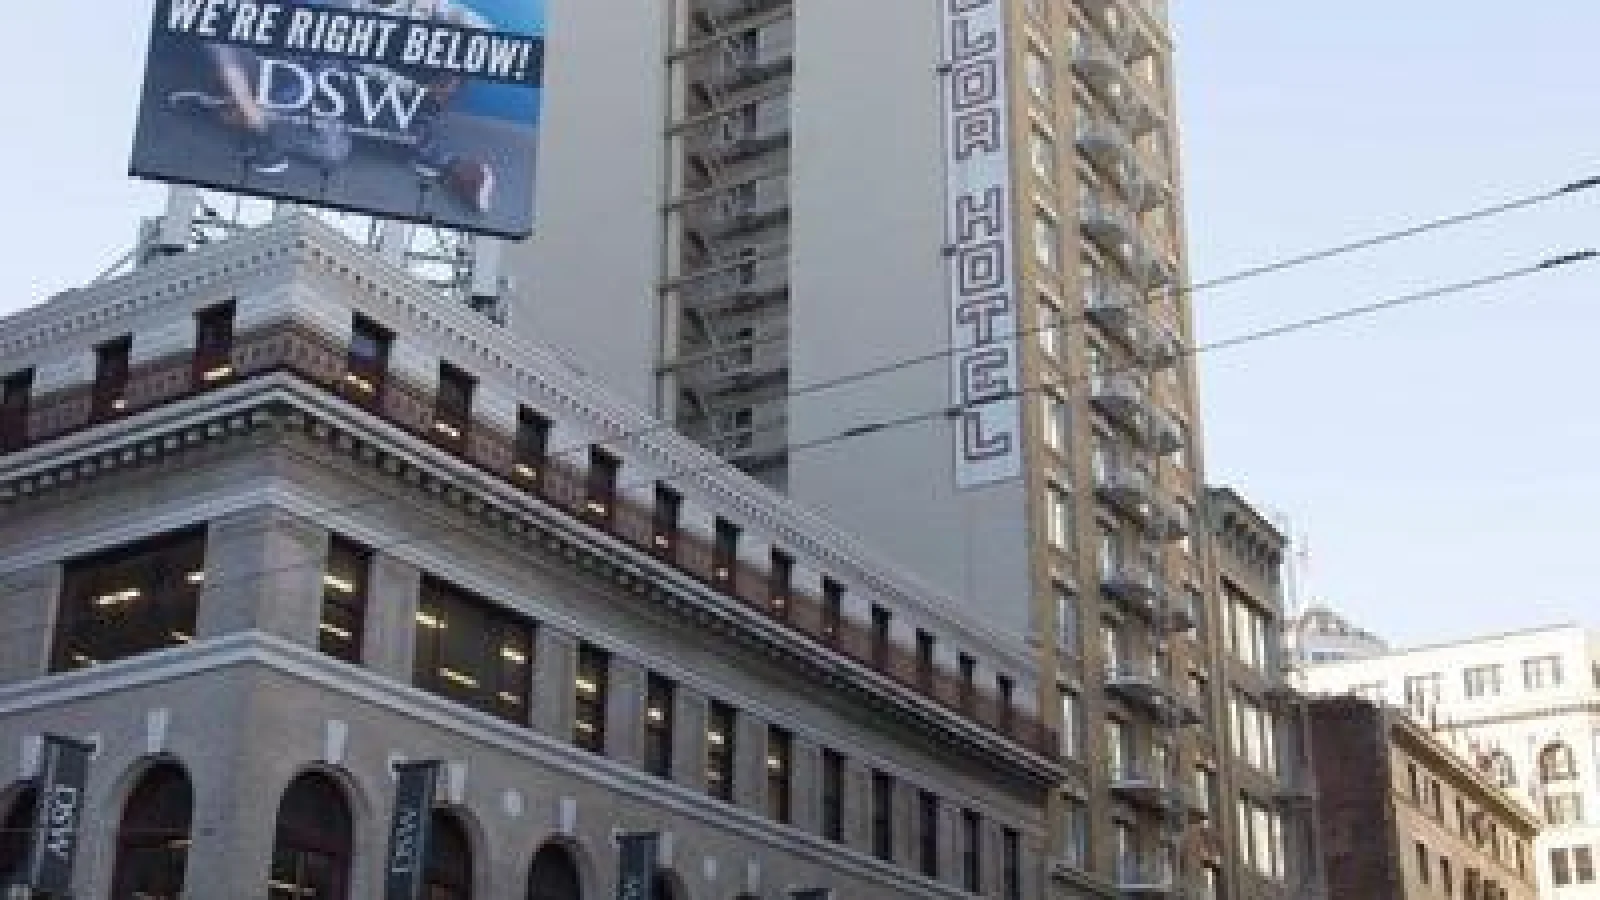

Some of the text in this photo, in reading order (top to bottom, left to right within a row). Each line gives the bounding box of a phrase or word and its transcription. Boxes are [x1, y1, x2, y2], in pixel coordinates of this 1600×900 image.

[167, 0, 532, 78] WE'RE RIGHT BELOW!
[256, 57, 428, 129] DSW
[950, 0, 1011, 461] LOR HOTEL
[46, 784, 77, 862] DSW
[391, 811, 418, 873] DSW
